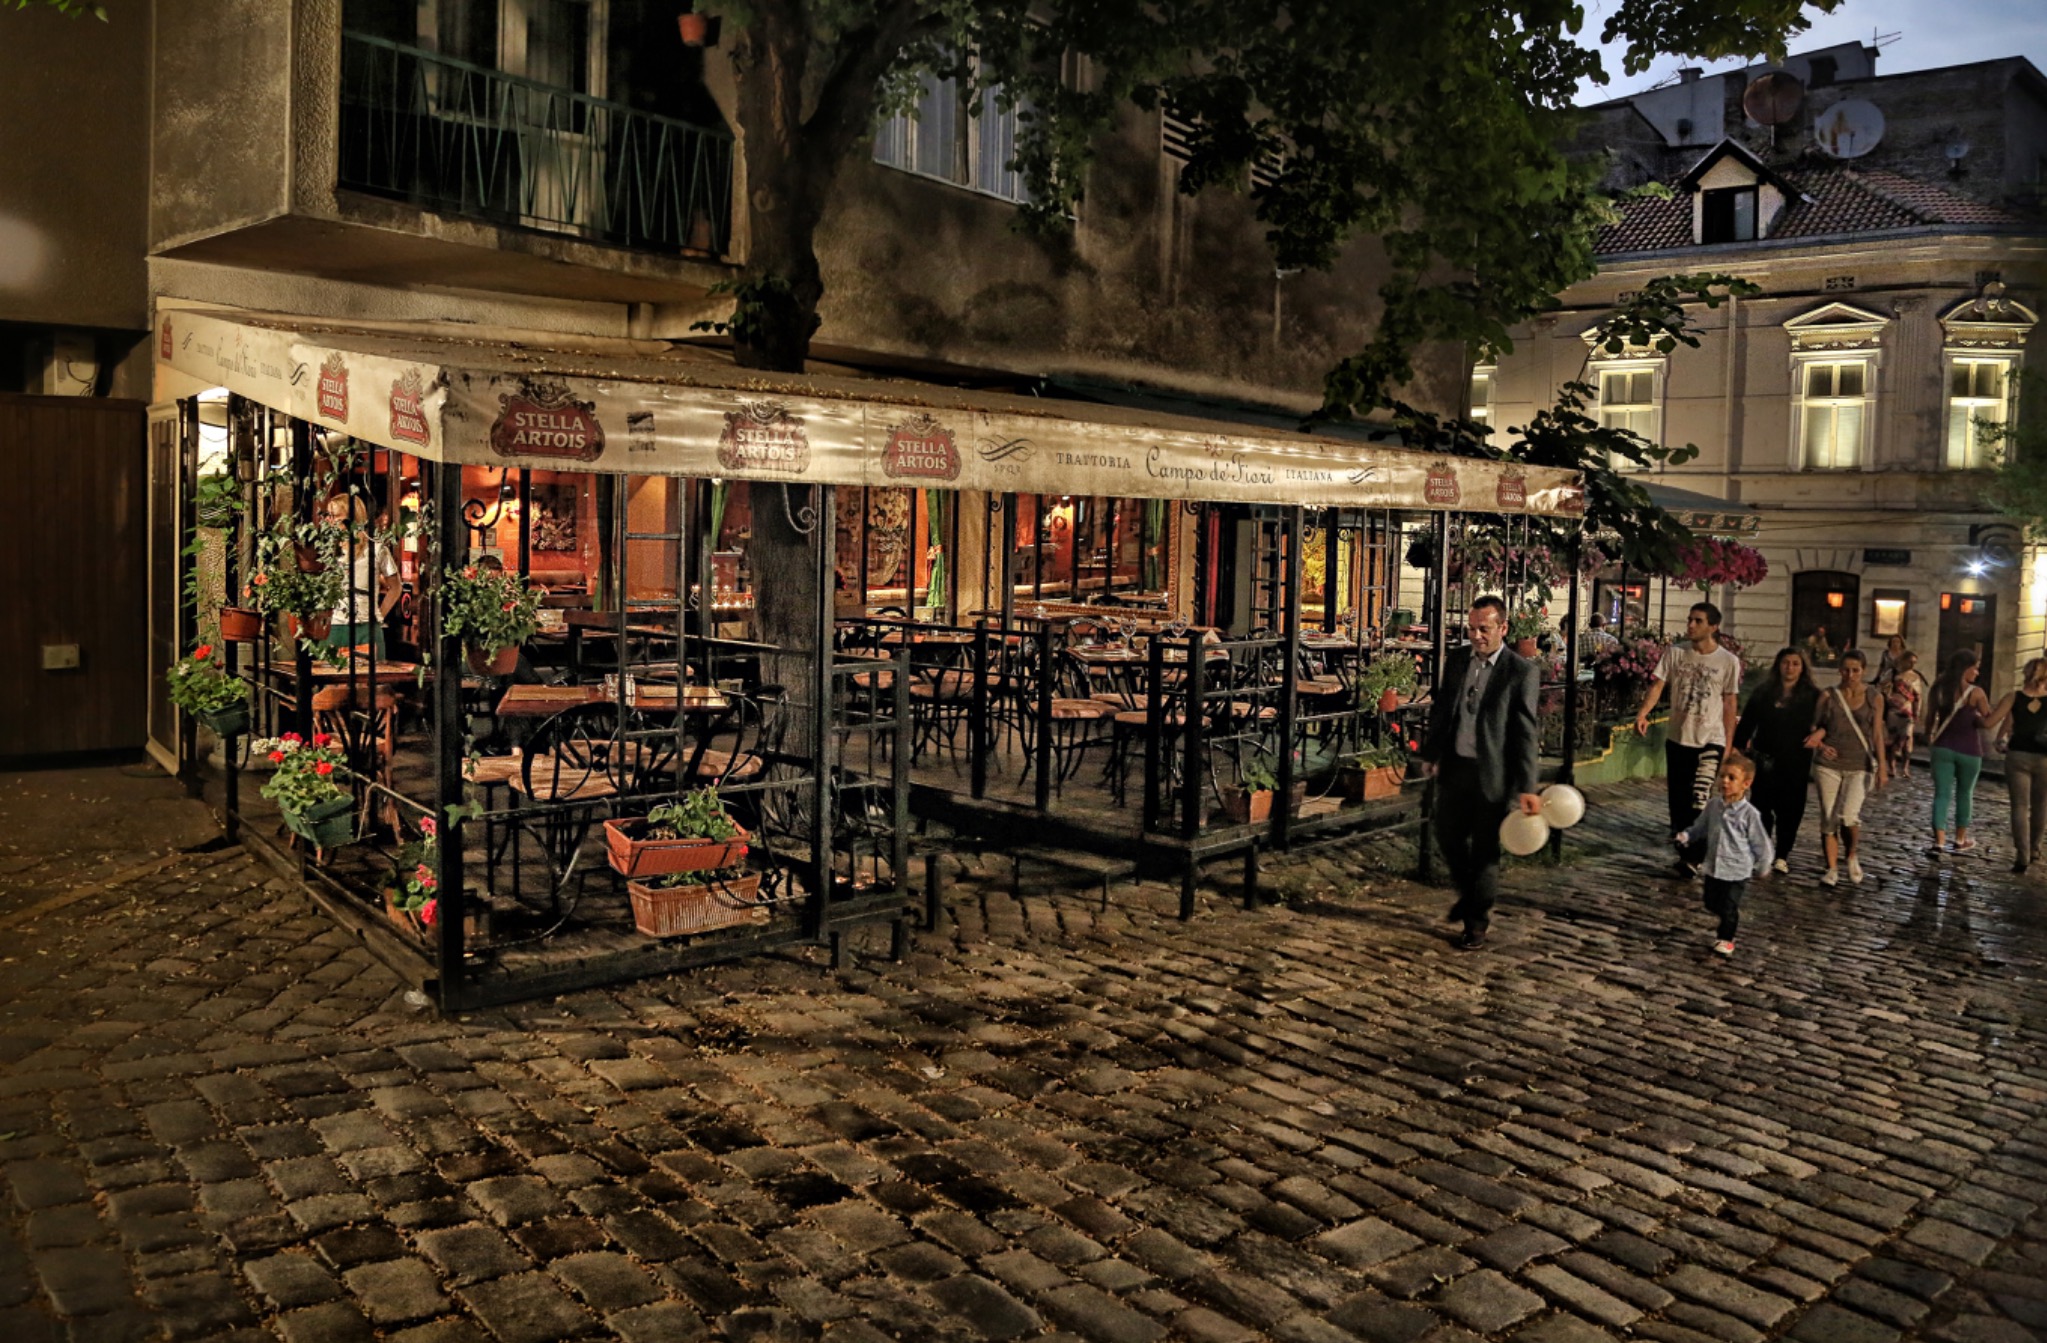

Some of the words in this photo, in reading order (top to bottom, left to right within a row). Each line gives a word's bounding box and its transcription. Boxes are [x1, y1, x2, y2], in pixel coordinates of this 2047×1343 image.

[321, 378, 343, 395] STELLA
[393, 396, 418, 416] STELLA
[514, 411, 586, 431] STELLA
[512, 429, 586, 449] ARTOIS
[736, 428, 795, 445] STELLA
[735, 445, 796, 461] ARTOIS
[897, 440, 947, 455] STELLA
[896, 454, 948, 470] ARTOIS
[1056, 452, 1131, 469] TRATTORIA
[1146, 446, 1204, 489] Campo
[1231, 453, 1275, 484] Fiori
[1285, 468, 1333, 482] ITALIANA
[1429, 477, 1453, 487] STELLA
